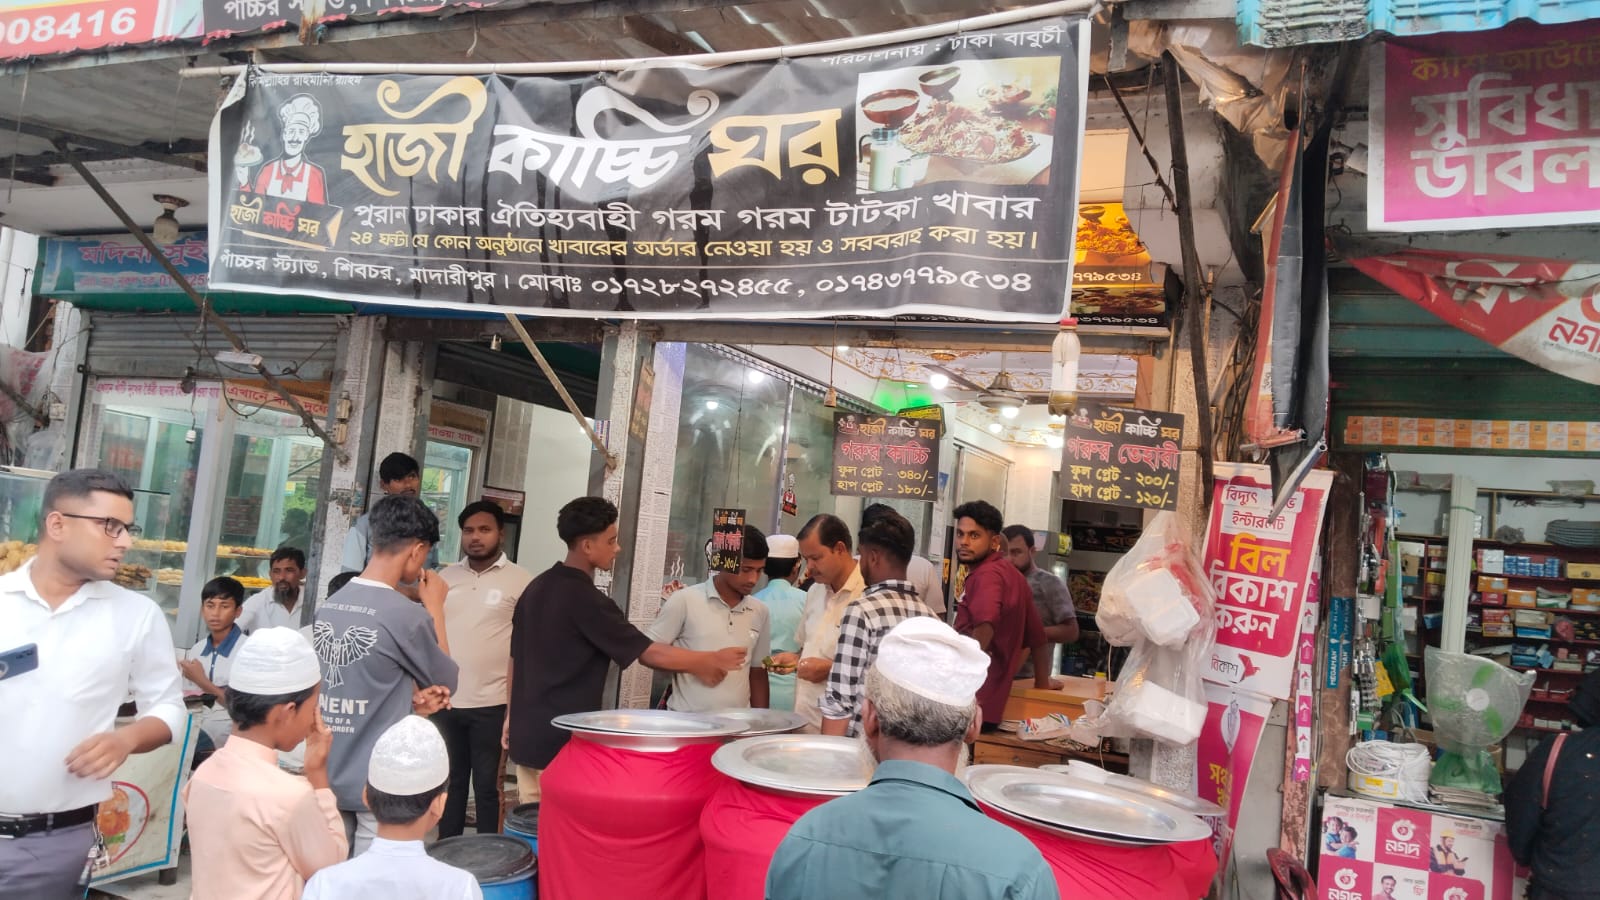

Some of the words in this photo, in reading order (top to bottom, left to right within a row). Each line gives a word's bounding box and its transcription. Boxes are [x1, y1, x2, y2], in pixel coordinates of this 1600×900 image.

[0, 7, 137, 46] 08416
[949, 30, 996, 50] ঢাকা
[340, 77, 487, 197] হাজী
[488, 85, 720, 190] কাচ্চি
[708, 108, 842, 184] ঘর
[1410, 136, 1600, 198] ডাবল
[230, 194, 263, 225] হাজী
[262, 202, 301, 232] কাচ্চি
[297, 217, 321, 237] ঘর
[354, 204, 407, 228] পুরান
[413, 205, 484, 227] ঢাকার
[491, 199, 641, 231] ঐতিহ্যবাহী
[652, 207, 726, 231] গরম
[737, 206, 816, 231] গরম
[824, 196, 922, 227] টাটকা
[932, 190, 1041, 220] খাবার
[79, 241, 151, 264] মদিনা
[163, 239, 208, 267] সুই
[351, 231, 371, 246] ২৪
[412, 232, 429, 248] যে
[434, 233, 471, 249] কোন
[475, 232, 543, 256] অনুষ্ঠানে
[548, 239, 627, 256] খাবারের
[633, 237, 697, 256] অর্ডার
[704, 239, 772, 257] নেওয়া
[779, 240, 812, 257] হয়
[817, 239, 833, 254] ও
[840, 228, 923, 252] সরবরাহ
[928, 226, 979, 246] করা
[816, 266, 1032, 293] ০১৭৪৩৭৭৯৫৩৪
[1073, 272, 1141, 282] ৭৭৯৫৩৪
[1080, 316, 1158, 324] ৩৭৭৯৫৩৪
[1548, 316, 1600, 353] নগ
[859, 417, 886, 436] হাজী
[888, 420, 919, 437] কাচ্চি
[1093, 411, 1124, 434] হাজী
[1125, 415, 1161, 438] কাচ্চি
[1160, 427, 1180, 440] ঘর
[841, 440, 882, 462] গরুর
[885, 440, 931, 464] কাচ্চি
[1067, 436, 1114, 463] গরুর
[1118, 440, 1182, 471] তেহারী
[837, 466, 857, 478] ফুল
[861, 465, 884, 478] প্লেট
[1070, 465, 1092, 482] ফুল
[1096, 465, 1121, 482] প্লেট
[861, 480, 884, 492] প্লেট
[1097, 484, 1121, 501] প্লেট
[1225, 486, 1258, 505] বিদ্যুৎ
[1229, 532, 1291, 577] বিল
[1209, 559, 1298, 612] বিকাশ
[1214, 602, 1280, 640] করুন
[1211, 653, 1239, 676] বিকাশ
[318, 692, 369, 716] NENT
[1385, 839, 1420, 858] নগদ
